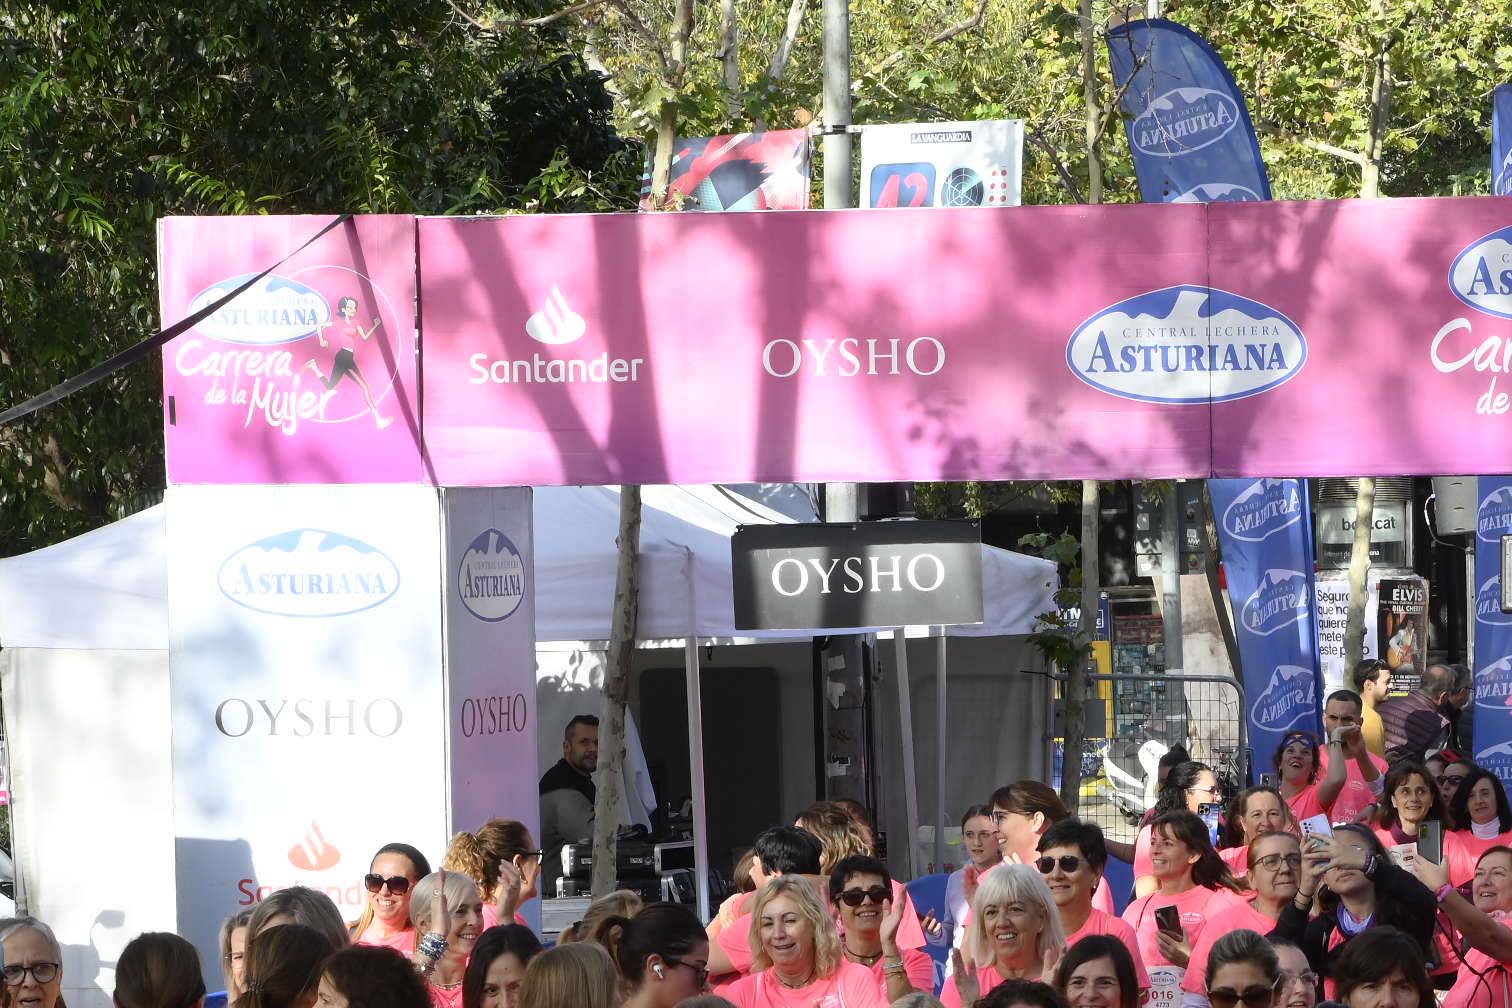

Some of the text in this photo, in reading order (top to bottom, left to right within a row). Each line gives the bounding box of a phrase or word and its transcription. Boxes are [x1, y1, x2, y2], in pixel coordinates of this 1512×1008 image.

[1122, 324, 1281, 339] CENTRAL LECHERA
[175, 339, 293, 376] Carrera
[470, 352, 644, 384] Santander
[762, 336, 946, 379] OYSHO
[1085, 329, 1289, 374] ASTURIANA
[244, 373, 337, 436] Mujer
[1474, 376, 1512, 415] de
[232, 558, 388, 595] ASTURIANA
[464, 563, 522, 599] ASTURIANA
[771, 553, 945, 597] OYSHO
[1392, 588, 1423, 601] ELVIS
[215, 697, 403, 739] OYSHO
[461, 693, 527, 738] OYSHO
[1151, 990, 1174, 1000] 016
